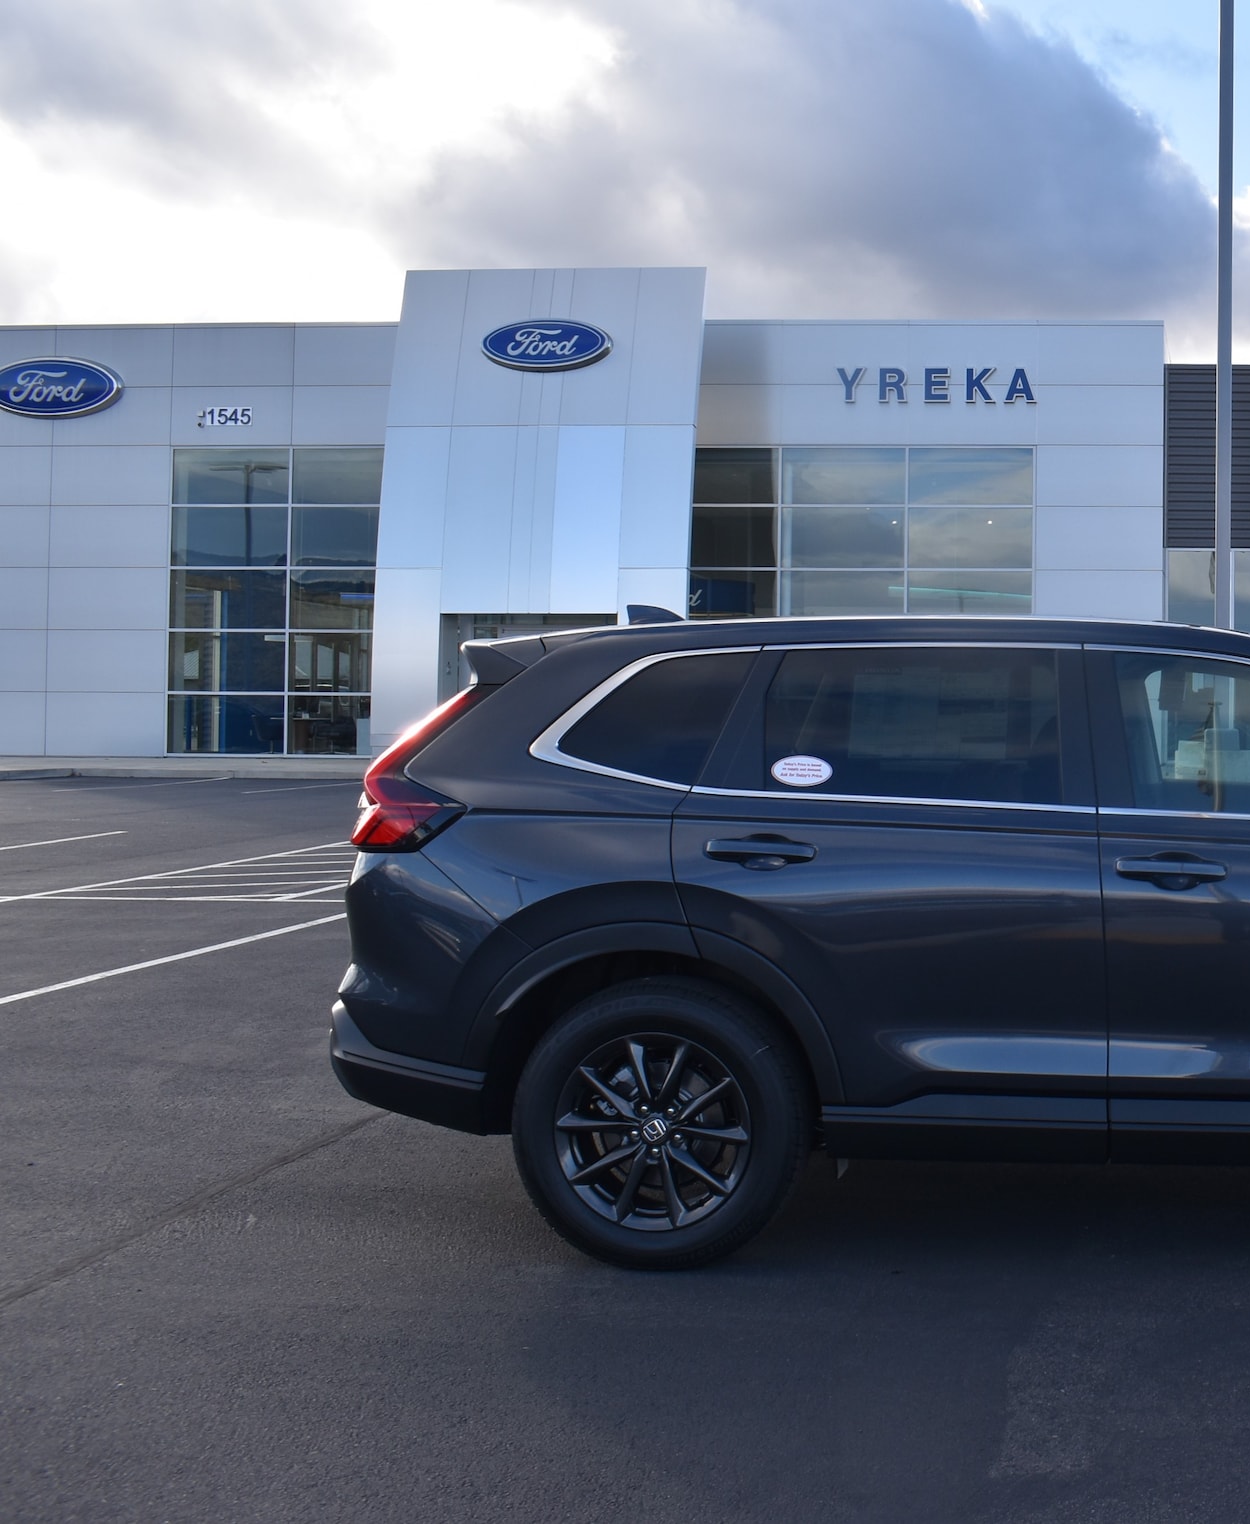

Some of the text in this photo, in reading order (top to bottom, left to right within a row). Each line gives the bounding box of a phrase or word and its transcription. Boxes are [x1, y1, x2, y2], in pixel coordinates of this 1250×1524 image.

[507, 328, 579, 356] Ford
[9, 370, 86, 403] Ford
[836, 367, 1038, 404] YREKA
[207, 408, 251, 425] 1545
